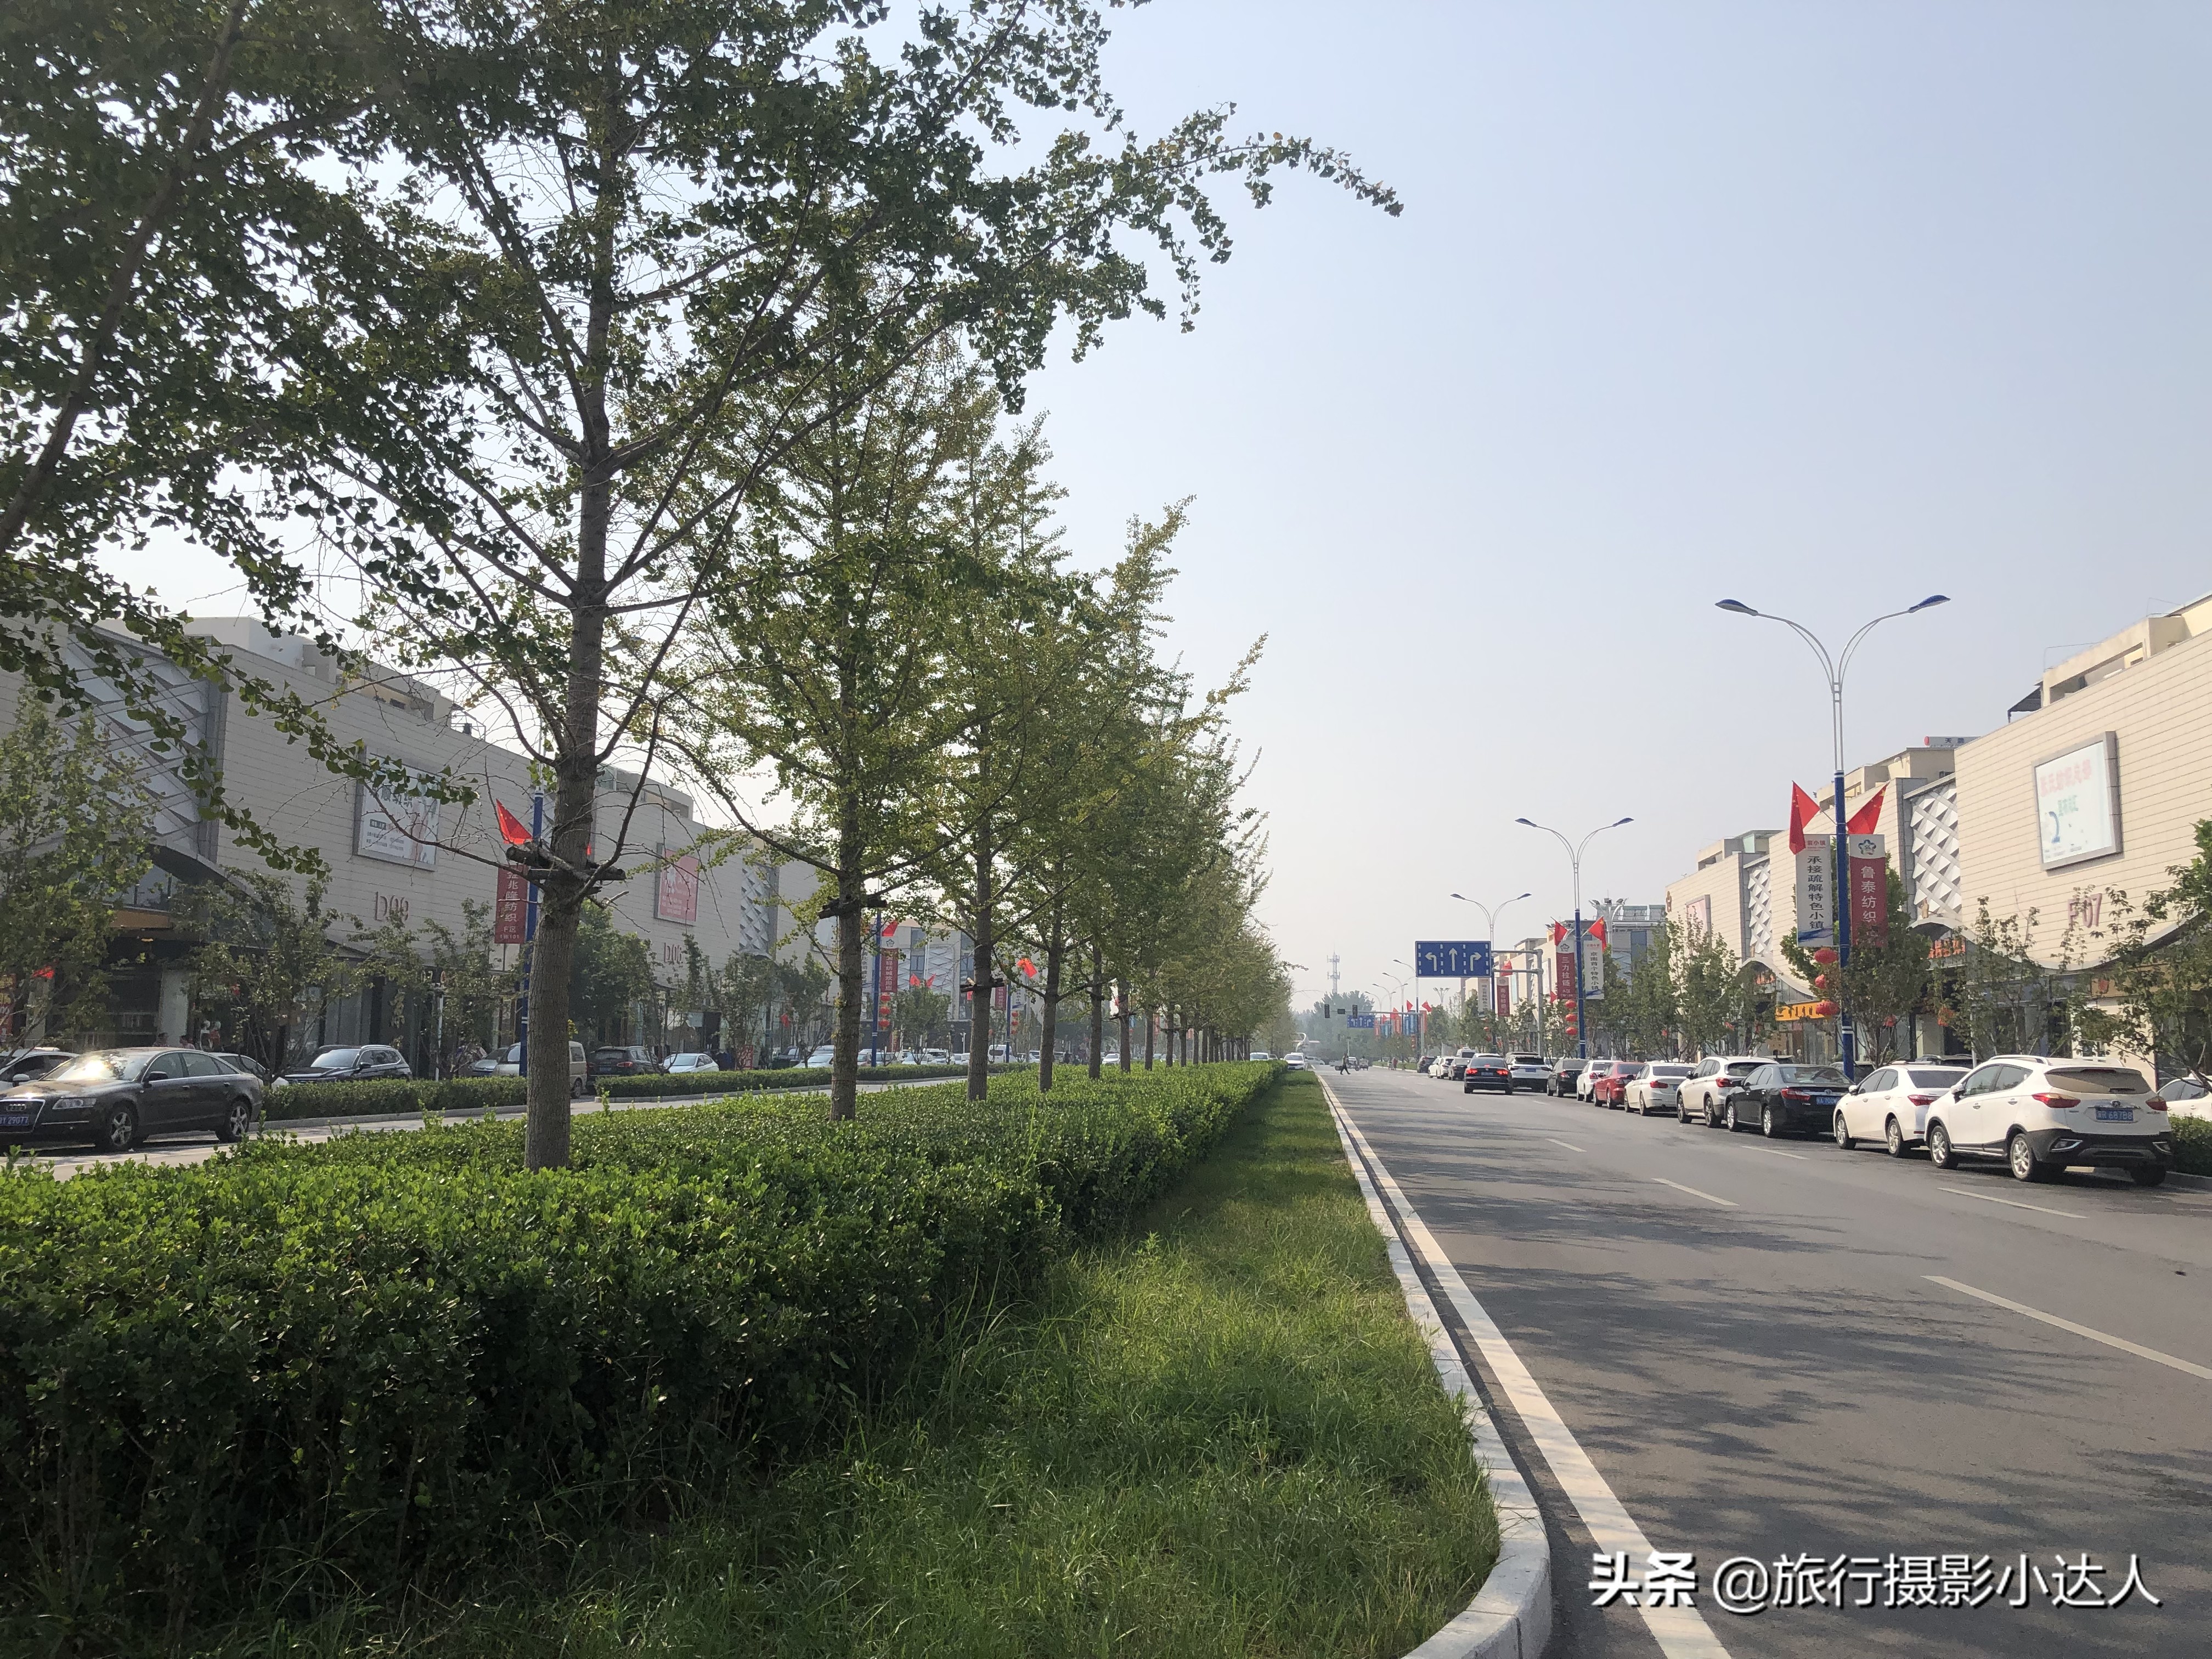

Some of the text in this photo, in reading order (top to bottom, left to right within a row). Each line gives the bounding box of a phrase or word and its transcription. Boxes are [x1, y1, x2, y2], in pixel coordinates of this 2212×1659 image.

[1807, 856, 1824, 929] 承接疏解特色小镇
[1861, 865, 1876, 923] 鲁泰纺织
